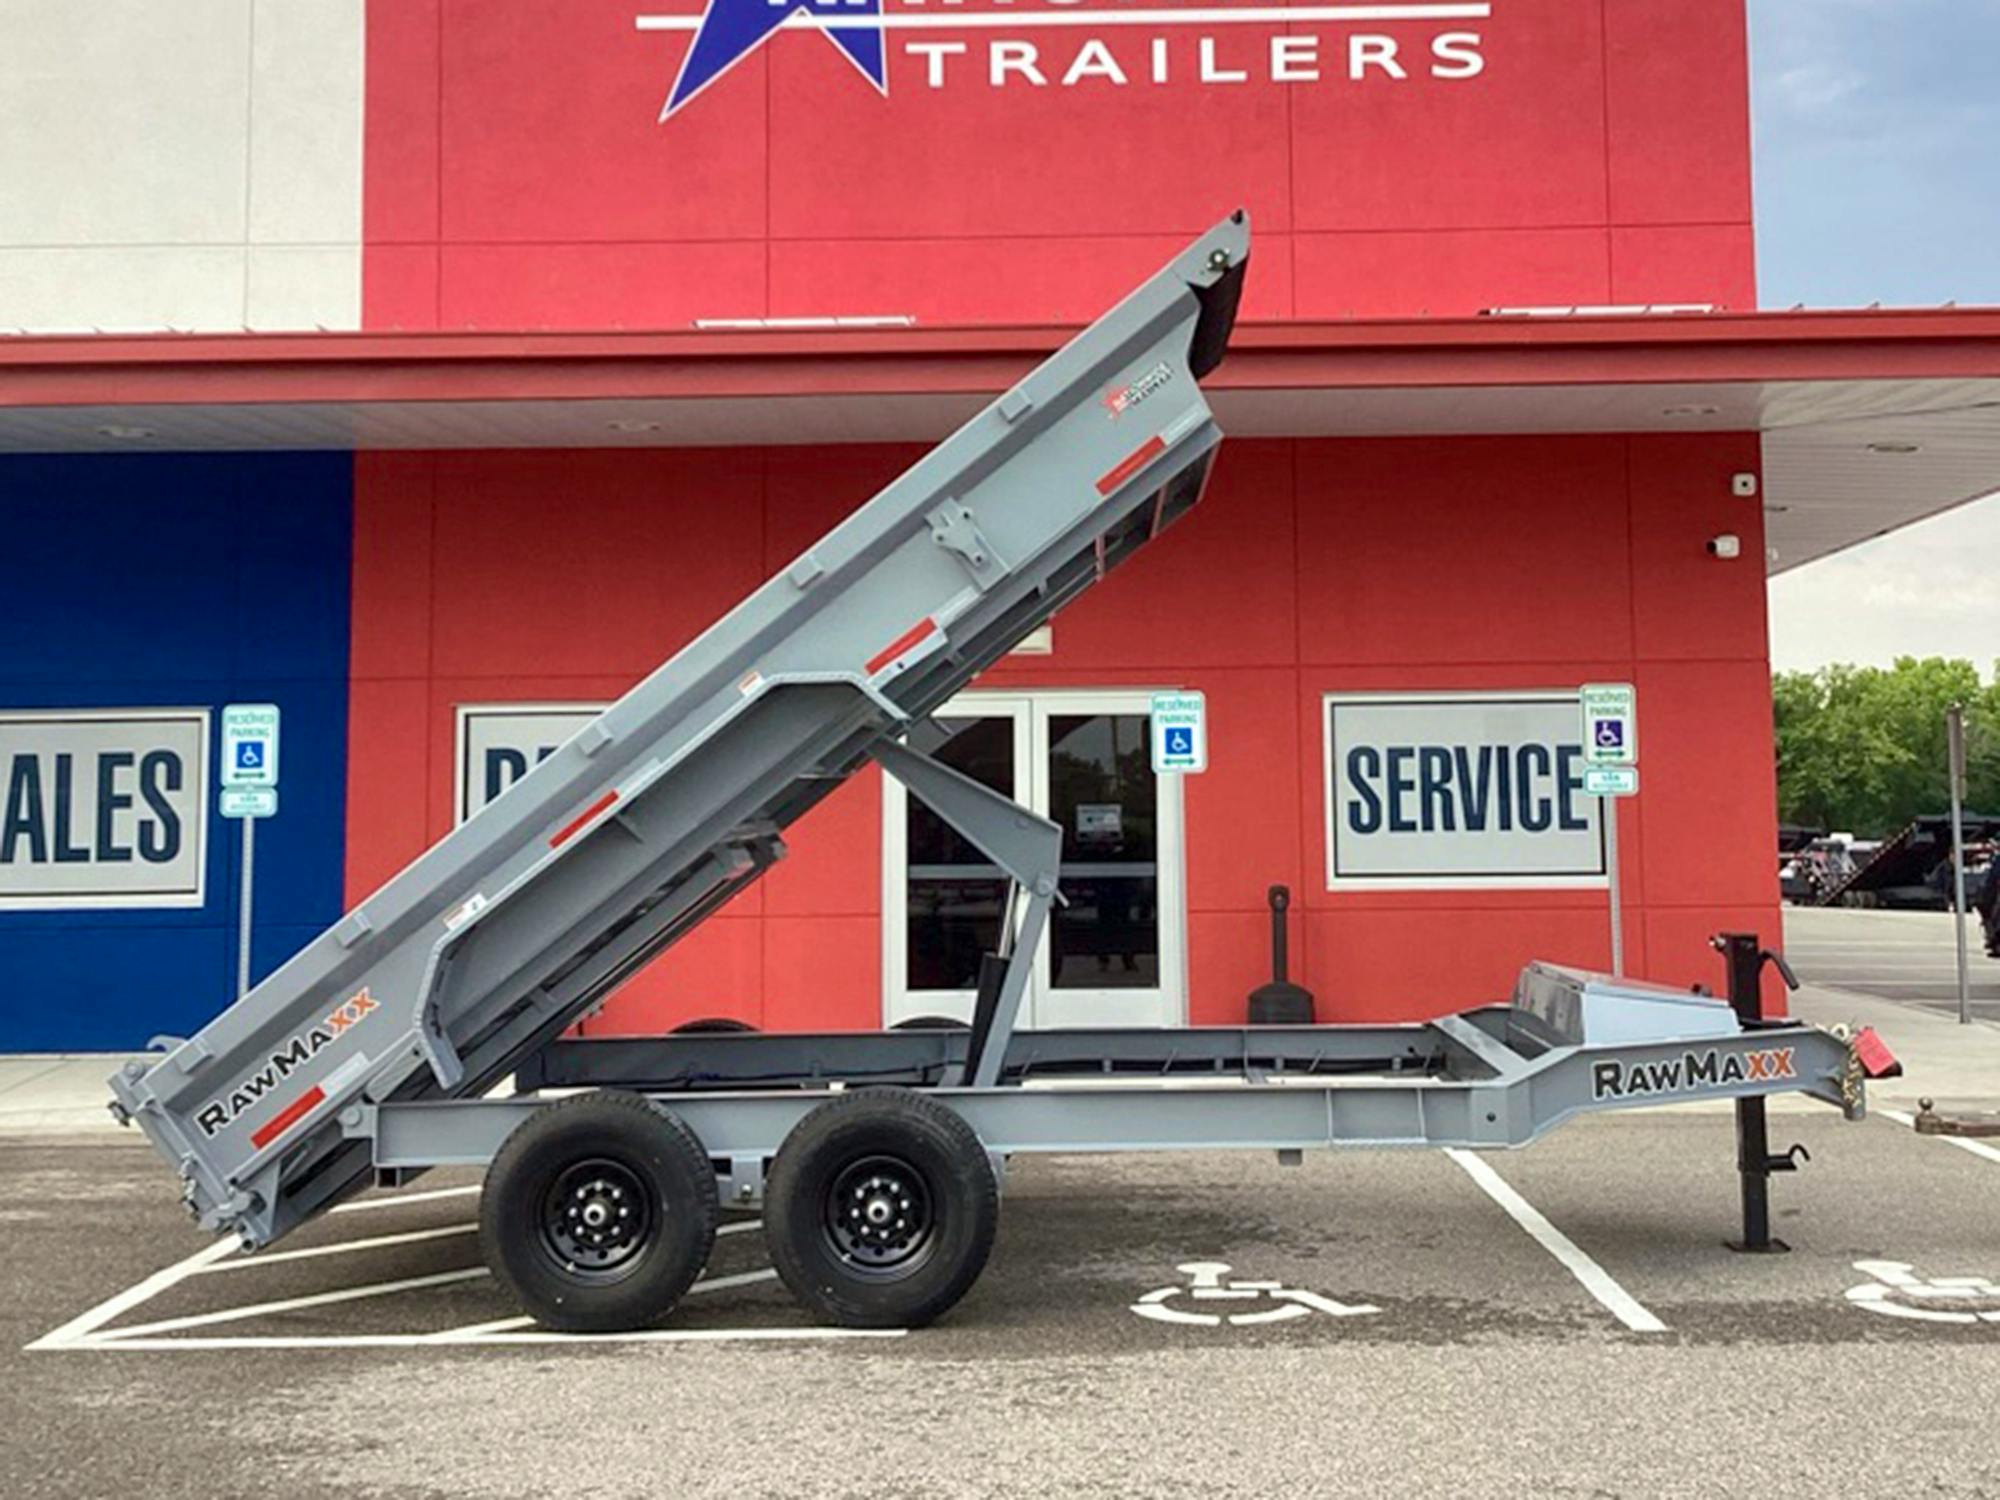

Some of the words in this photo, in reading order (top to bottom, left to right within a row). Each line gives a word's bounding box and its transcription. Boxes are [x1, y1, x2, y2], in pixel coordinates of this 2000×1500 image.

[904, 32, 1485, 88] TRAILERS
[0, 749, 183, 864] ALES
[1346, 743, 1589, 834] SERVICE
